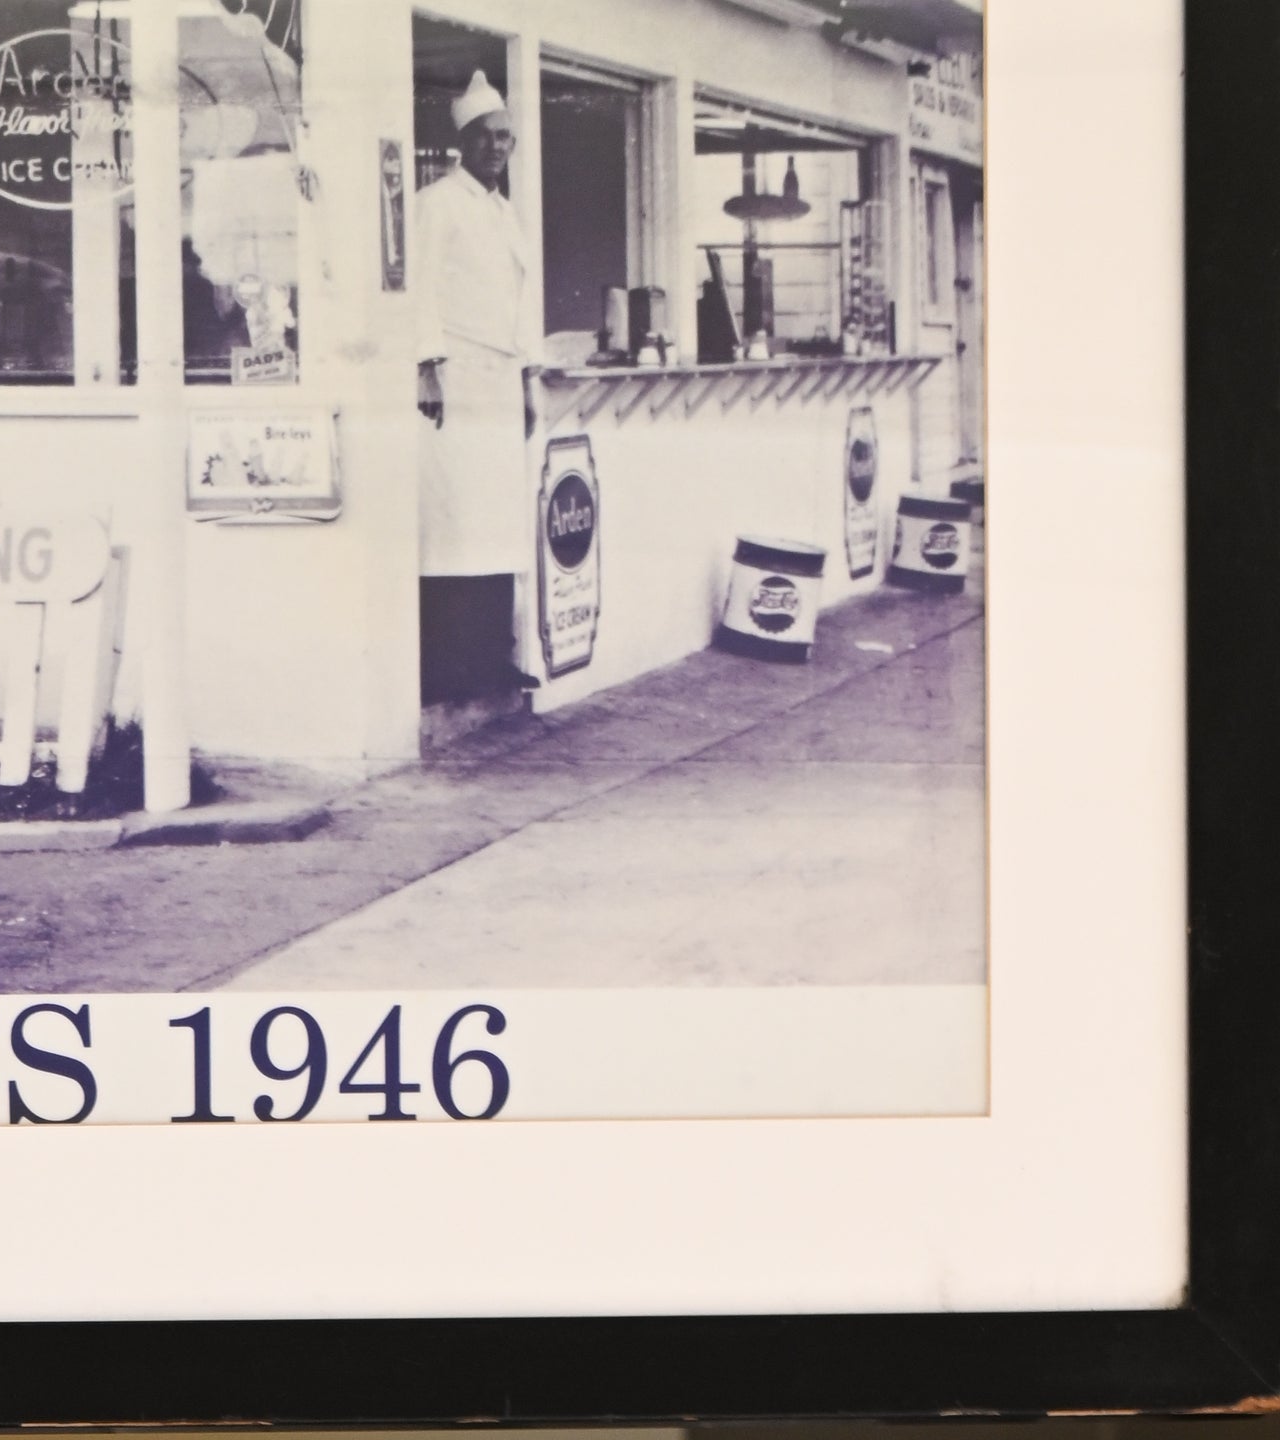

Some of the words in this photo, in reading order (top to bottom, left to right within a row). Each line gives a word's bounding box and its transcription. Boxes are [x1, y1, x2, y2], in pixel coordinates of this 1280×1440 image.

[1, 158, 44, 183] ICE
[551, 497, 590, 538] Arden
[169, 1004, 510, 1124] 1946
